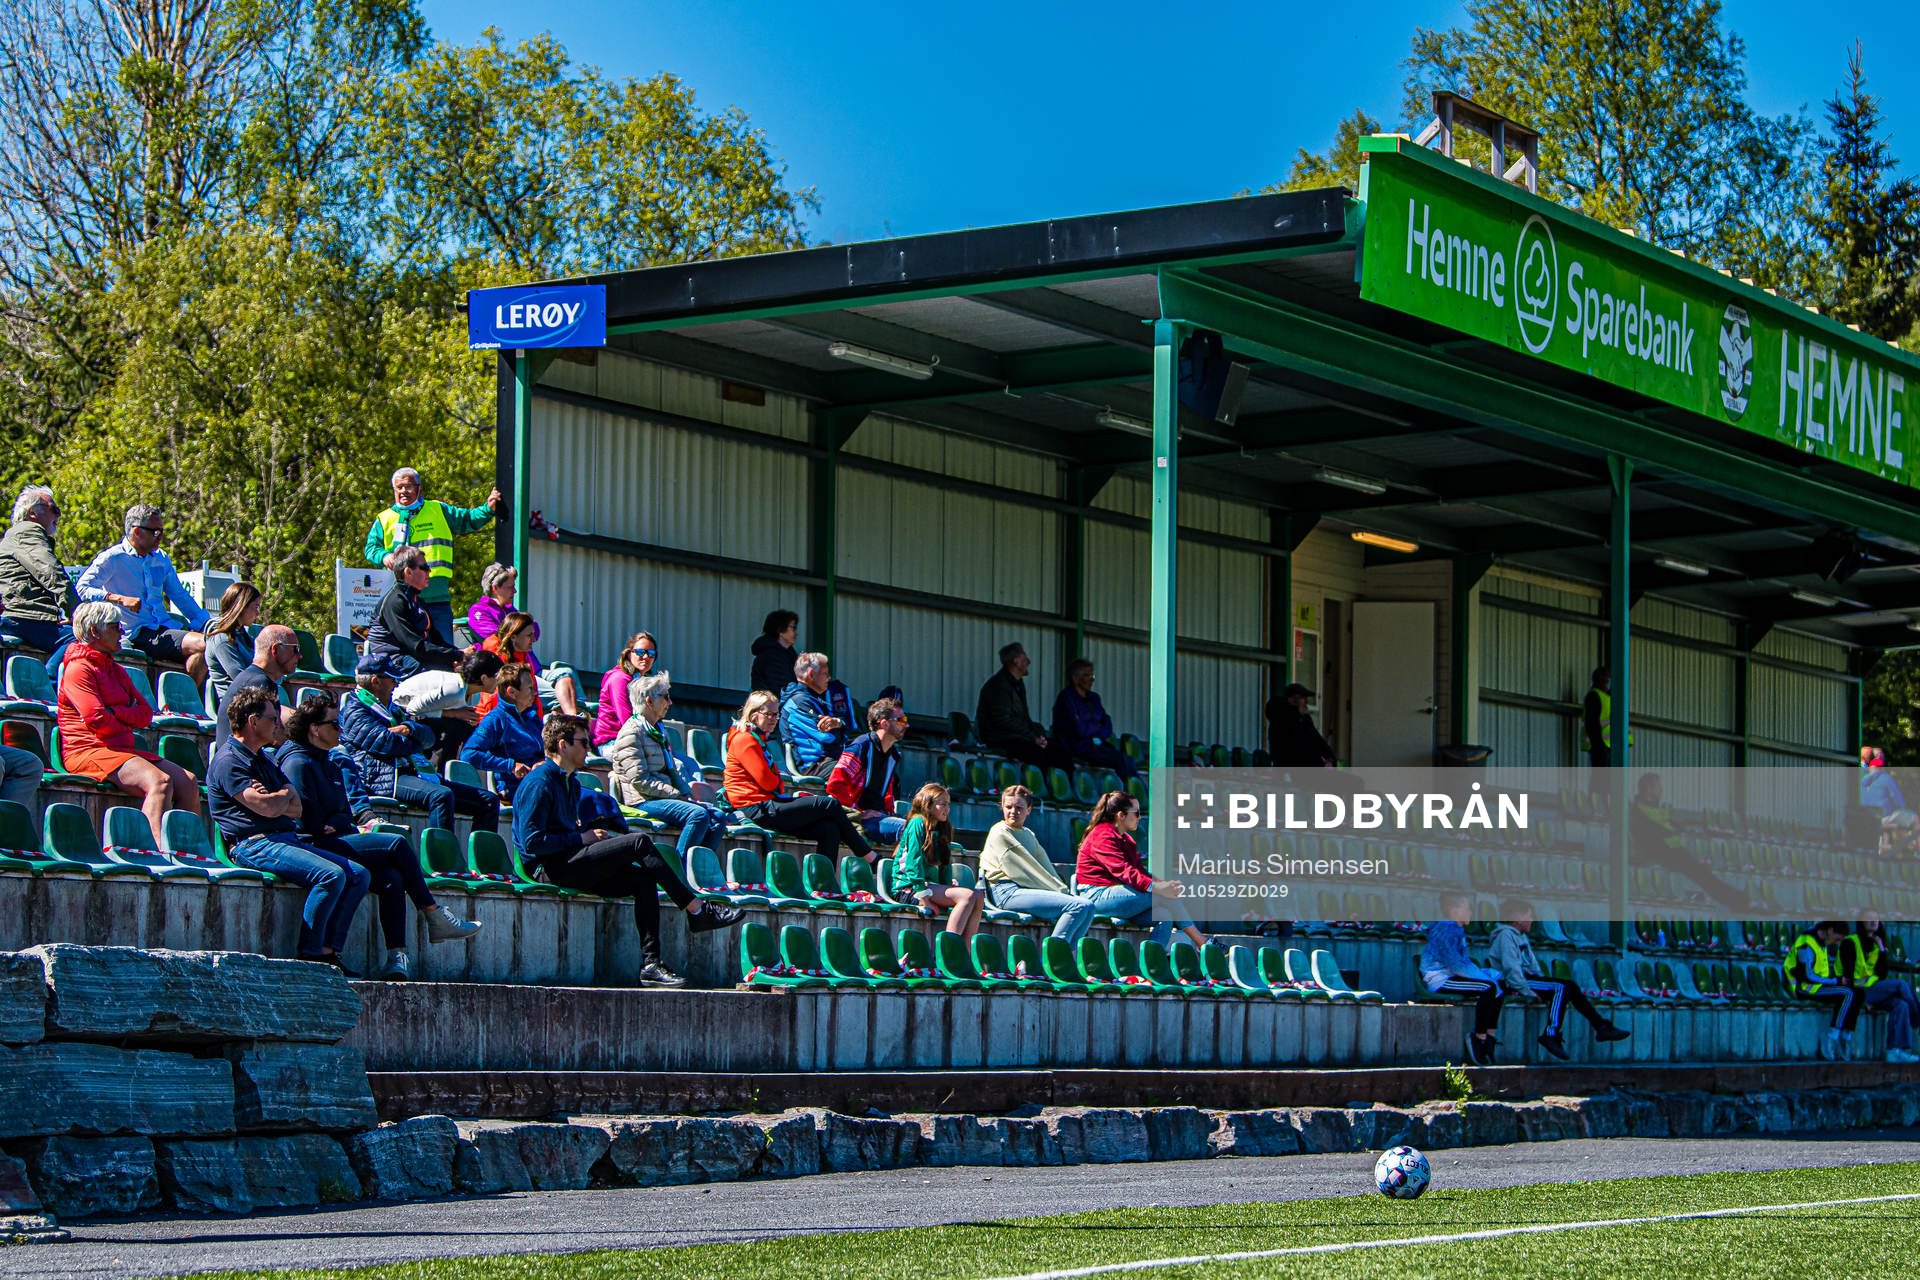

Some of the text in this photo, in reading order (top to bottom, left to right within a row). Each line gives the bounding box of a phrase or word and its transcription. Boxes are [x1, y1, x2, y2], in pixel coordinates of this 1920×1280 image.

[496, 302, 581, 329] LERØY
[1406, 198, 1695, 376] Hemne Sparebank
[1779, 329, 1905, 469] HEMNE
